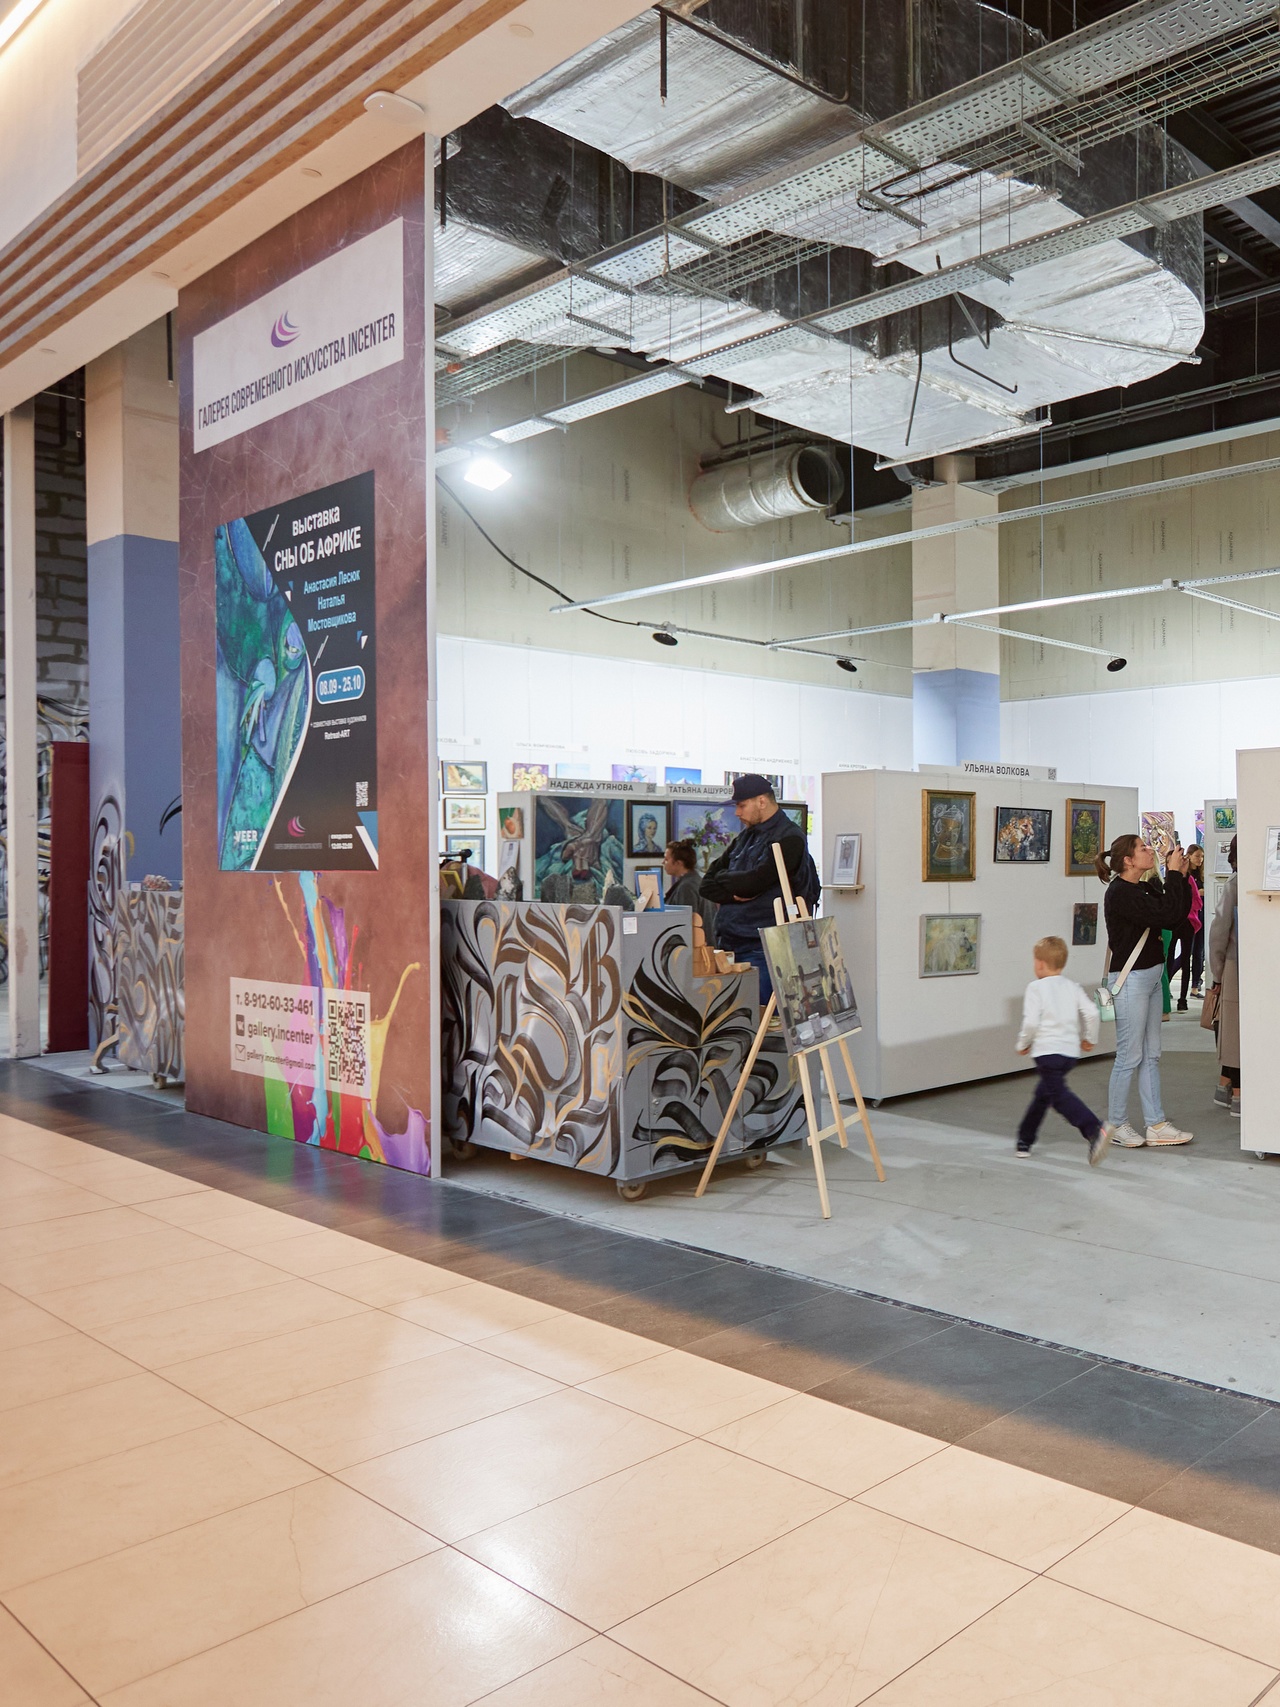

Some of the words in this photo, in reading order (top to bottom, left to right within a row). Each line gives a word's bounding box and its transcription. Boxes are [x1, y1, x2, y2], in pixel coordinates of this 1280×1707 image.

[198, 395, 231, 430] ГАЛЕРЕЯ
[231, 363, 293, 413] СОВРЕМЕННОГО
[294, 337, 346, 383] ИСКУССТВА
[348, 313, 396, 358] INCENTER
[274, 545, 298, 572] СНЫ
[299, 540, 315, 564] ОБ
[316, 525, 362, 560] АФРИКЕ
[303, 575, 338, 595] Анастасия
[338, 569, 361, 587] Лесюк
[317, 594, 346, 610] Наталья
[307, 611, 357, 632] Мостовщикова
[319, 678, 338, 696] 08.09
[342, 674, 361, 692] 25.10
[964, 763, 995, 774] УЛЬЯНА
[996, 765, 1030, 777] ВОЛКОВА
[550, 780, 594, 791] НАДЕЖДА
[596, 783, 634, 792] УТЯНОВА
[669, 785, 702, 794] ТАТЬЯНА
[703, 786, 733, 796] АШУРОВ
[244, 991, 314, 1016] 8-912-60-33-461
[247, 1020, 314, 1045] gallery.incenter
[246, 1050, 317, 1071] gallery.incenter@gmail.com
